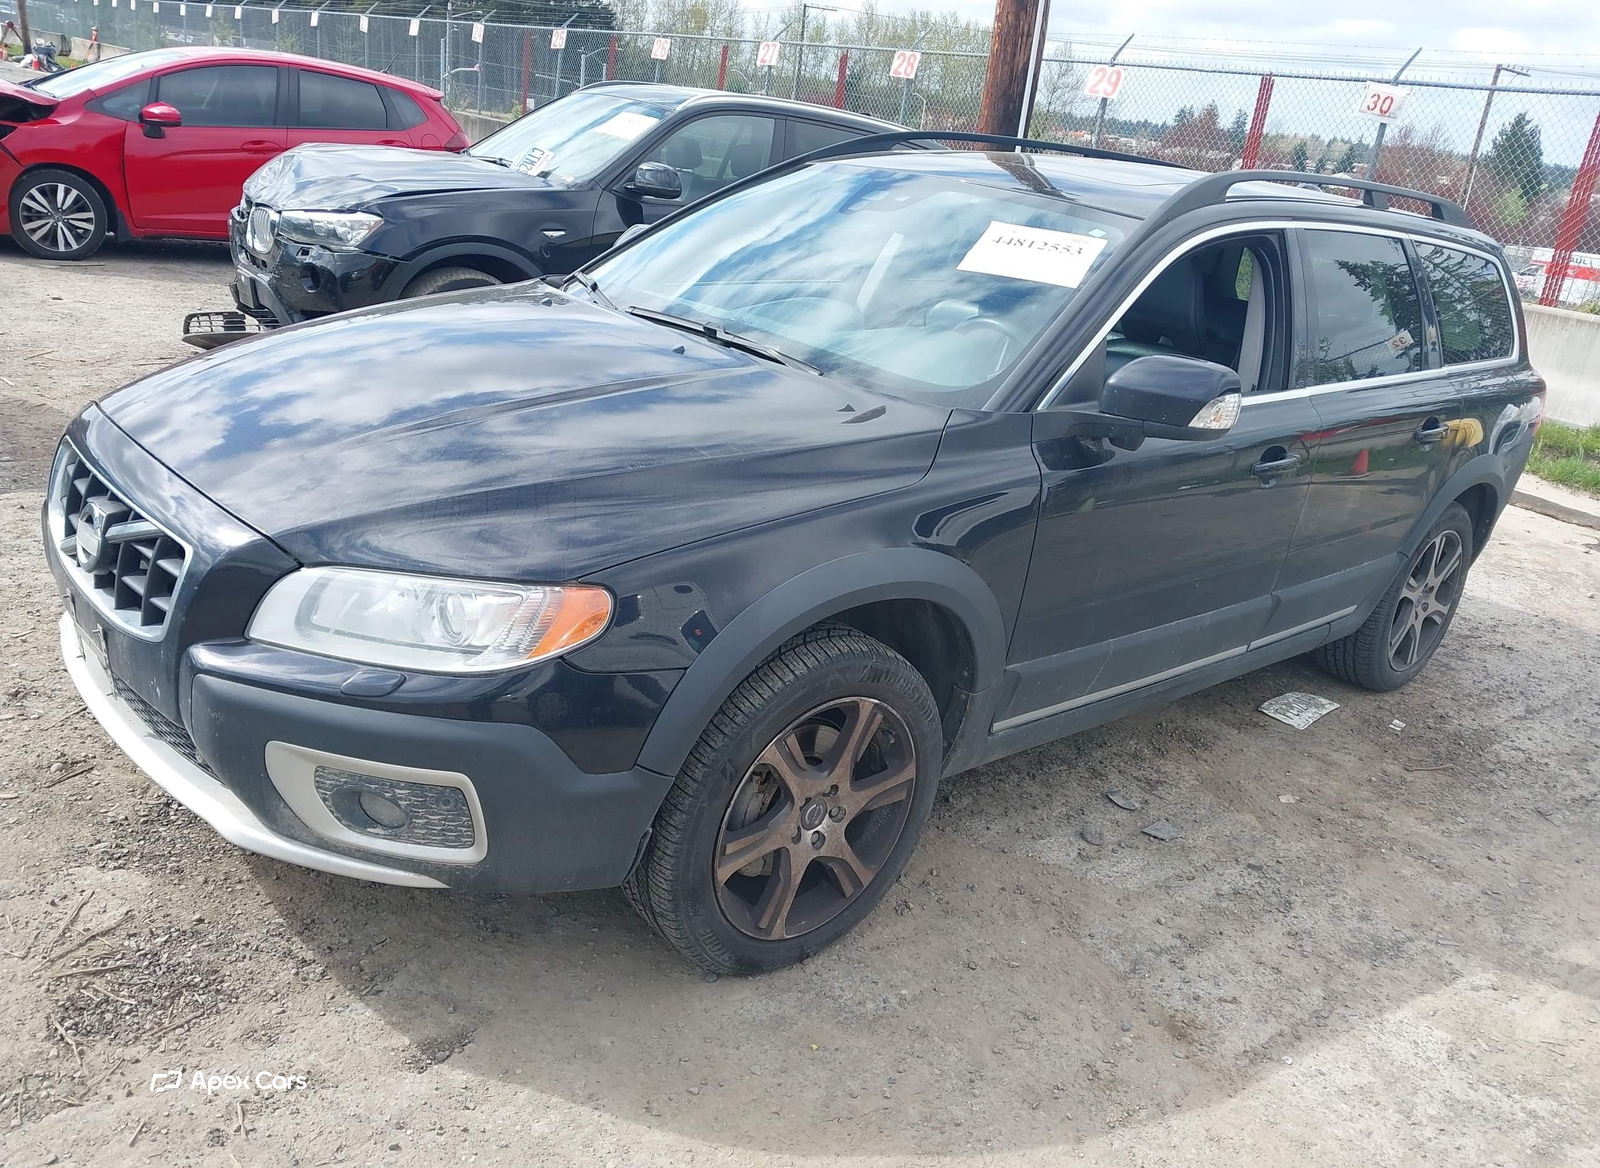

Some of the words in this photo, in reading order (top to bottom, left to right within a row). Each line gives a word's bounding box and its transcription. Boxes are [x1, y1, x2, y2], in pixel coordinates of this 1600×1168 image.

[553, 29, 566, 47] 25
[653, 39, 669, 58] 26
[760, 43, 777, 63] 27
[893, 52, 917, 76] 28
[1088, 67, 1121, 96] 29
[1367, 93, 1394, 114] 30
[992, 236, 1083, 255] 44812553
